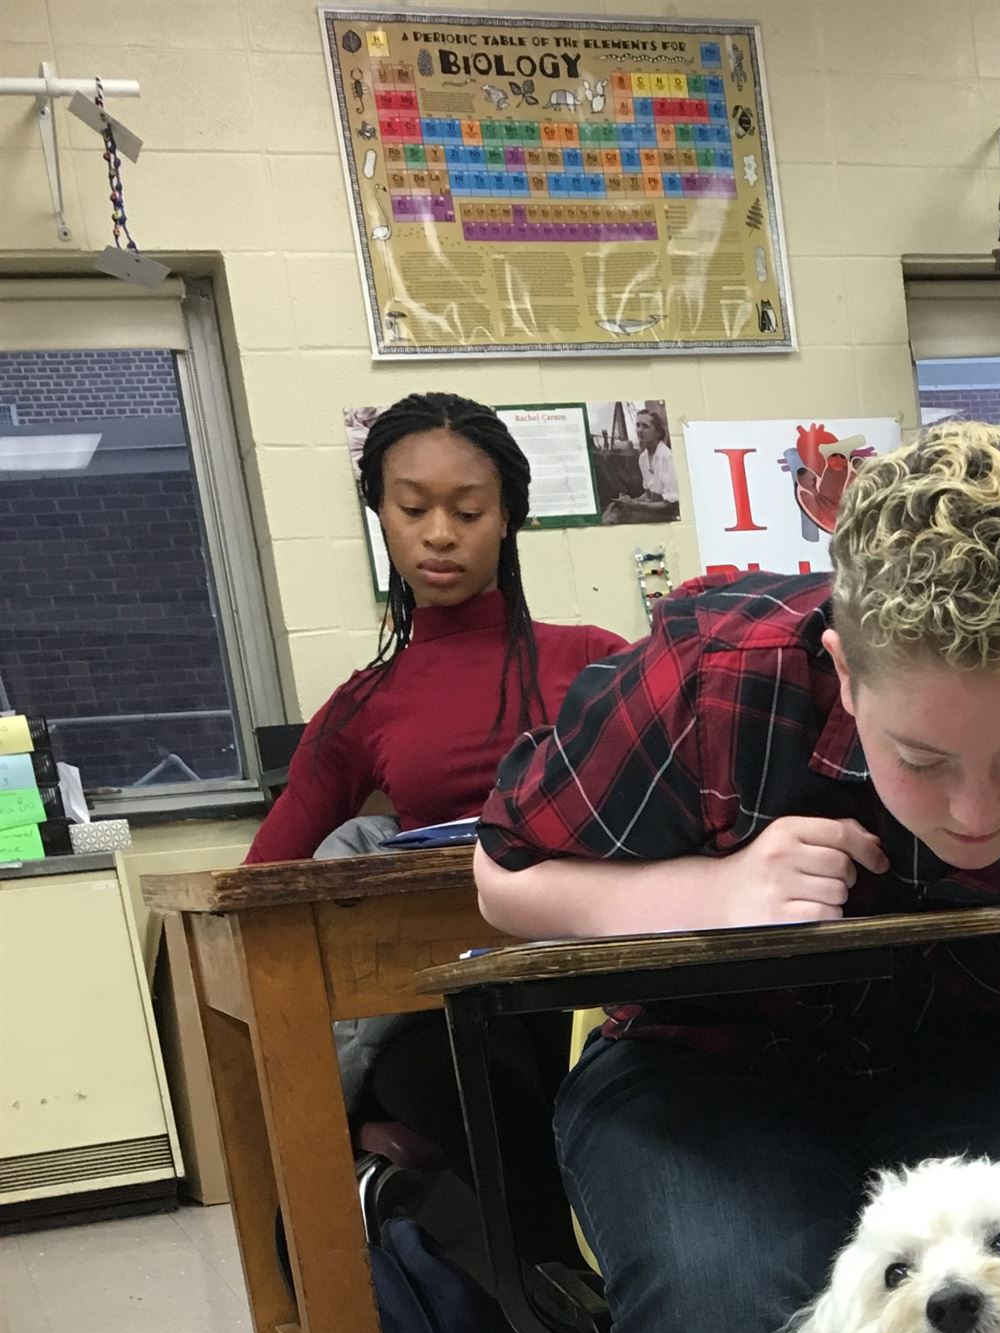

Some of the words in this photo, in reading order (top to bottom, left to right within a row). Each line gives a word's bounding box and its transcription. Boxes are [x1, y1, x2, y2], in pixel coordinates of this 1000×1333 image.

[401, 32, 408, 41] A
[413, 31, 477, 45] PERIODIC
[482, 35, 527, 47] TABLE
[531, 36, 549, 47] OF
[553, 37, 578, 48] THE
[583, 37, 657, 51] ELEMENTS
[662, 41, 686, 51] FOR
[438, 49, 582, 78] BIOLOGY
[515, 414, 540, 422] Rachel
[714, 448, 768, 532] I
